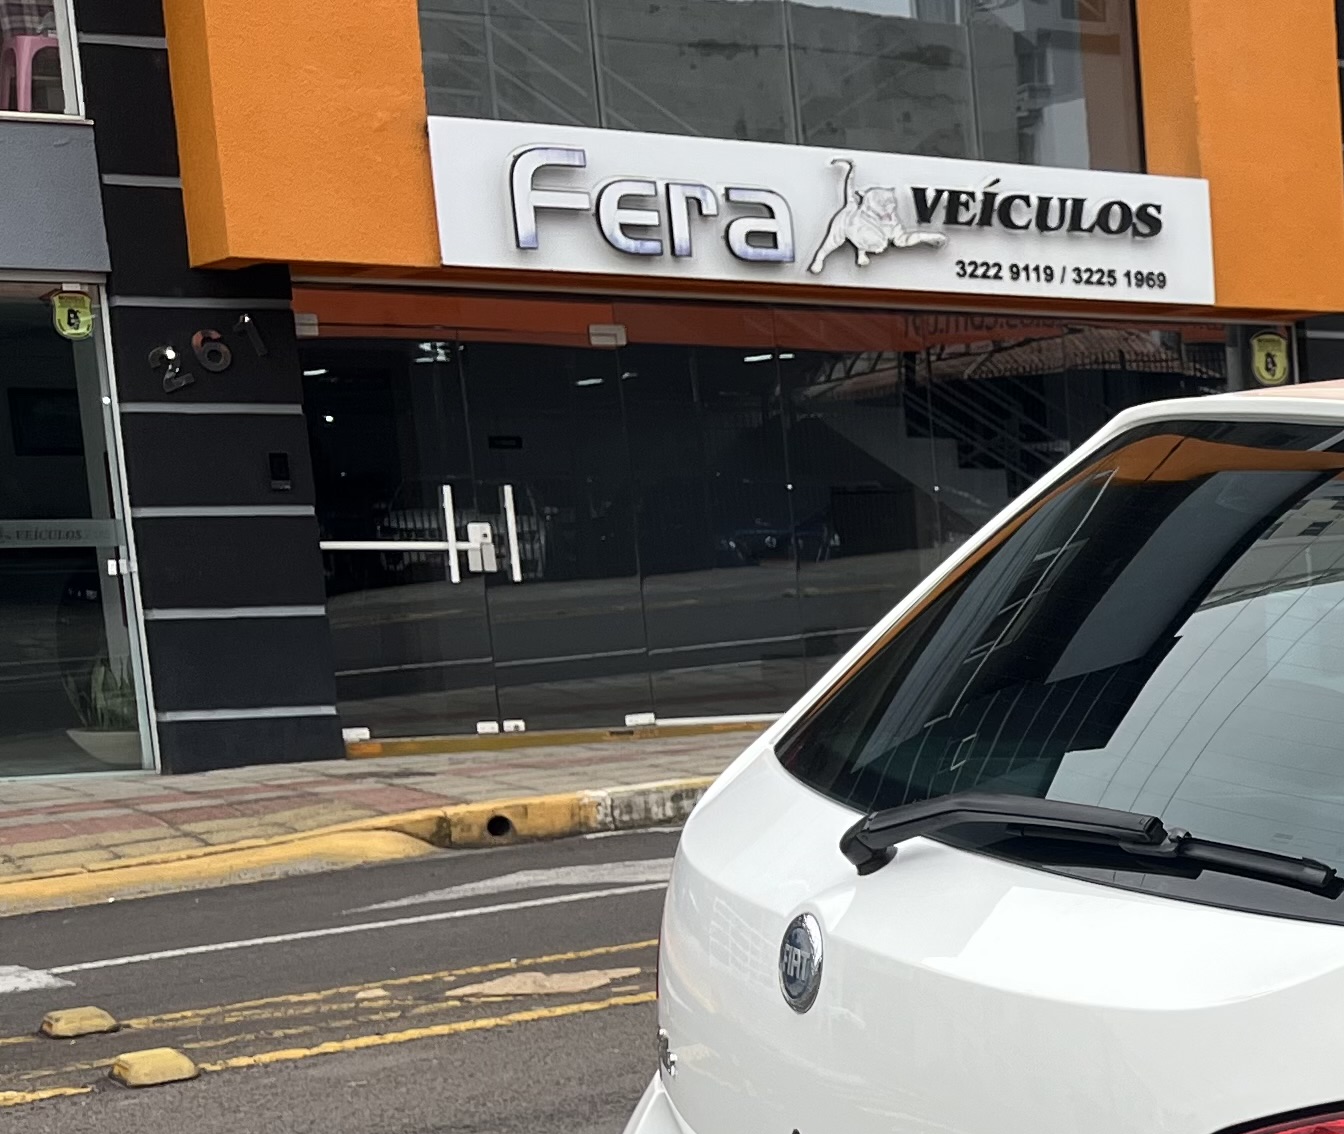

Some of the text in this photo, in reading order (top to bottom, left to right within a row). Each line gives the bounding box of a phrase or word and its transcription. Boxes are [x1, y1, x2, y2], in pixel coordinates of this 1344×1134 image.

[509, 145, 796, 263] Fera
[911, 177, 1164, 239] VEÍCULOS
[955, 260, 1168, 290] 3222 9119 / 3225 1969
[148, 312, 268, 394] 261
[783, 943, 812, 980] FIAT
